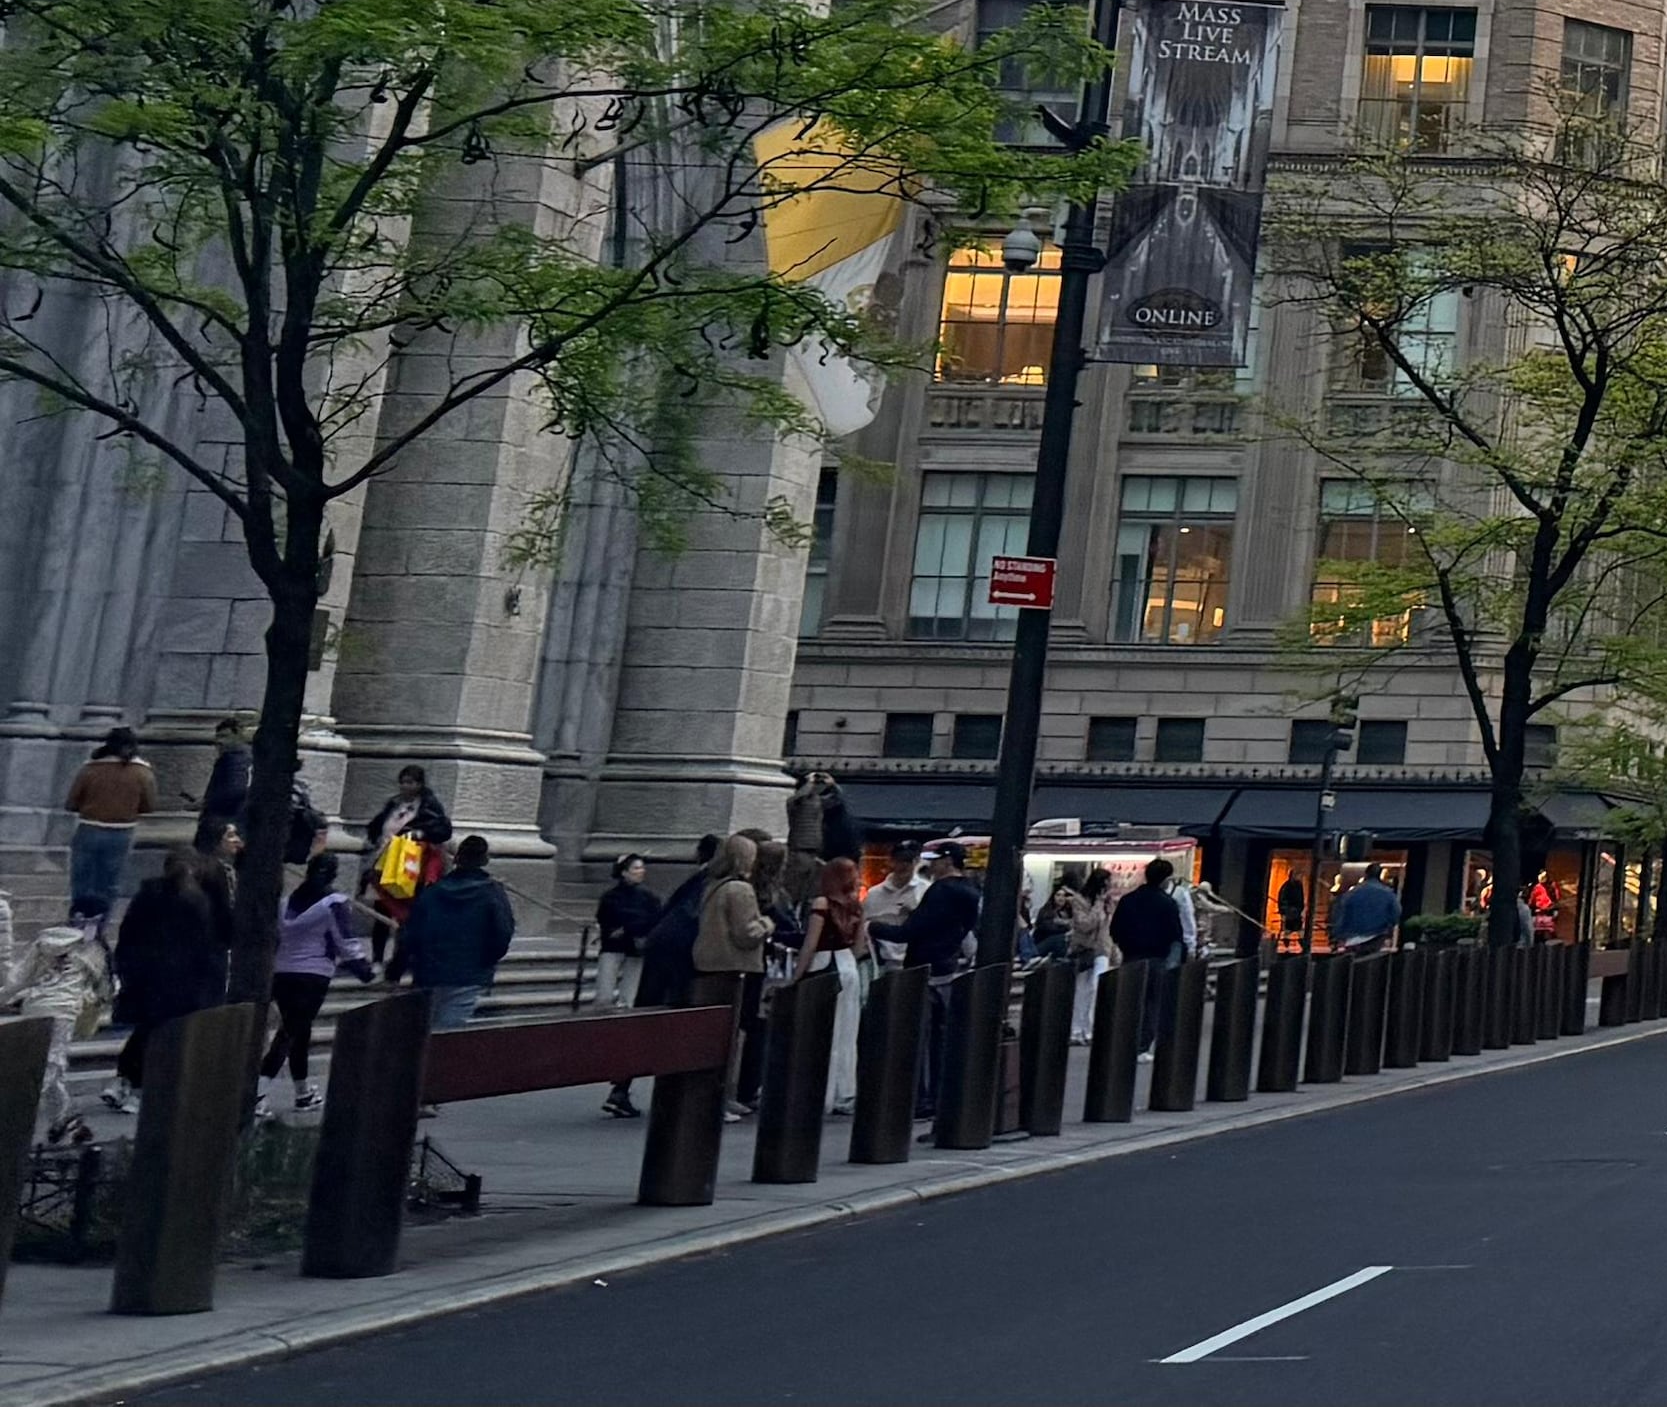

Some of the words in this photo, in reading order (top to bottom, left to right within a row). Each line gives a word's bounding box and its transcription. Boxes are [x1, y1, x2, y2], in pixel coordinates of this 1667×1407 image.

[1176, 2, 1241, 25] MASS
[1181, 21, 1234, 44] LIVE
[1158, 39, 1250, 65] STREAM
[1135, 307, 1215, 326] ONLINE
